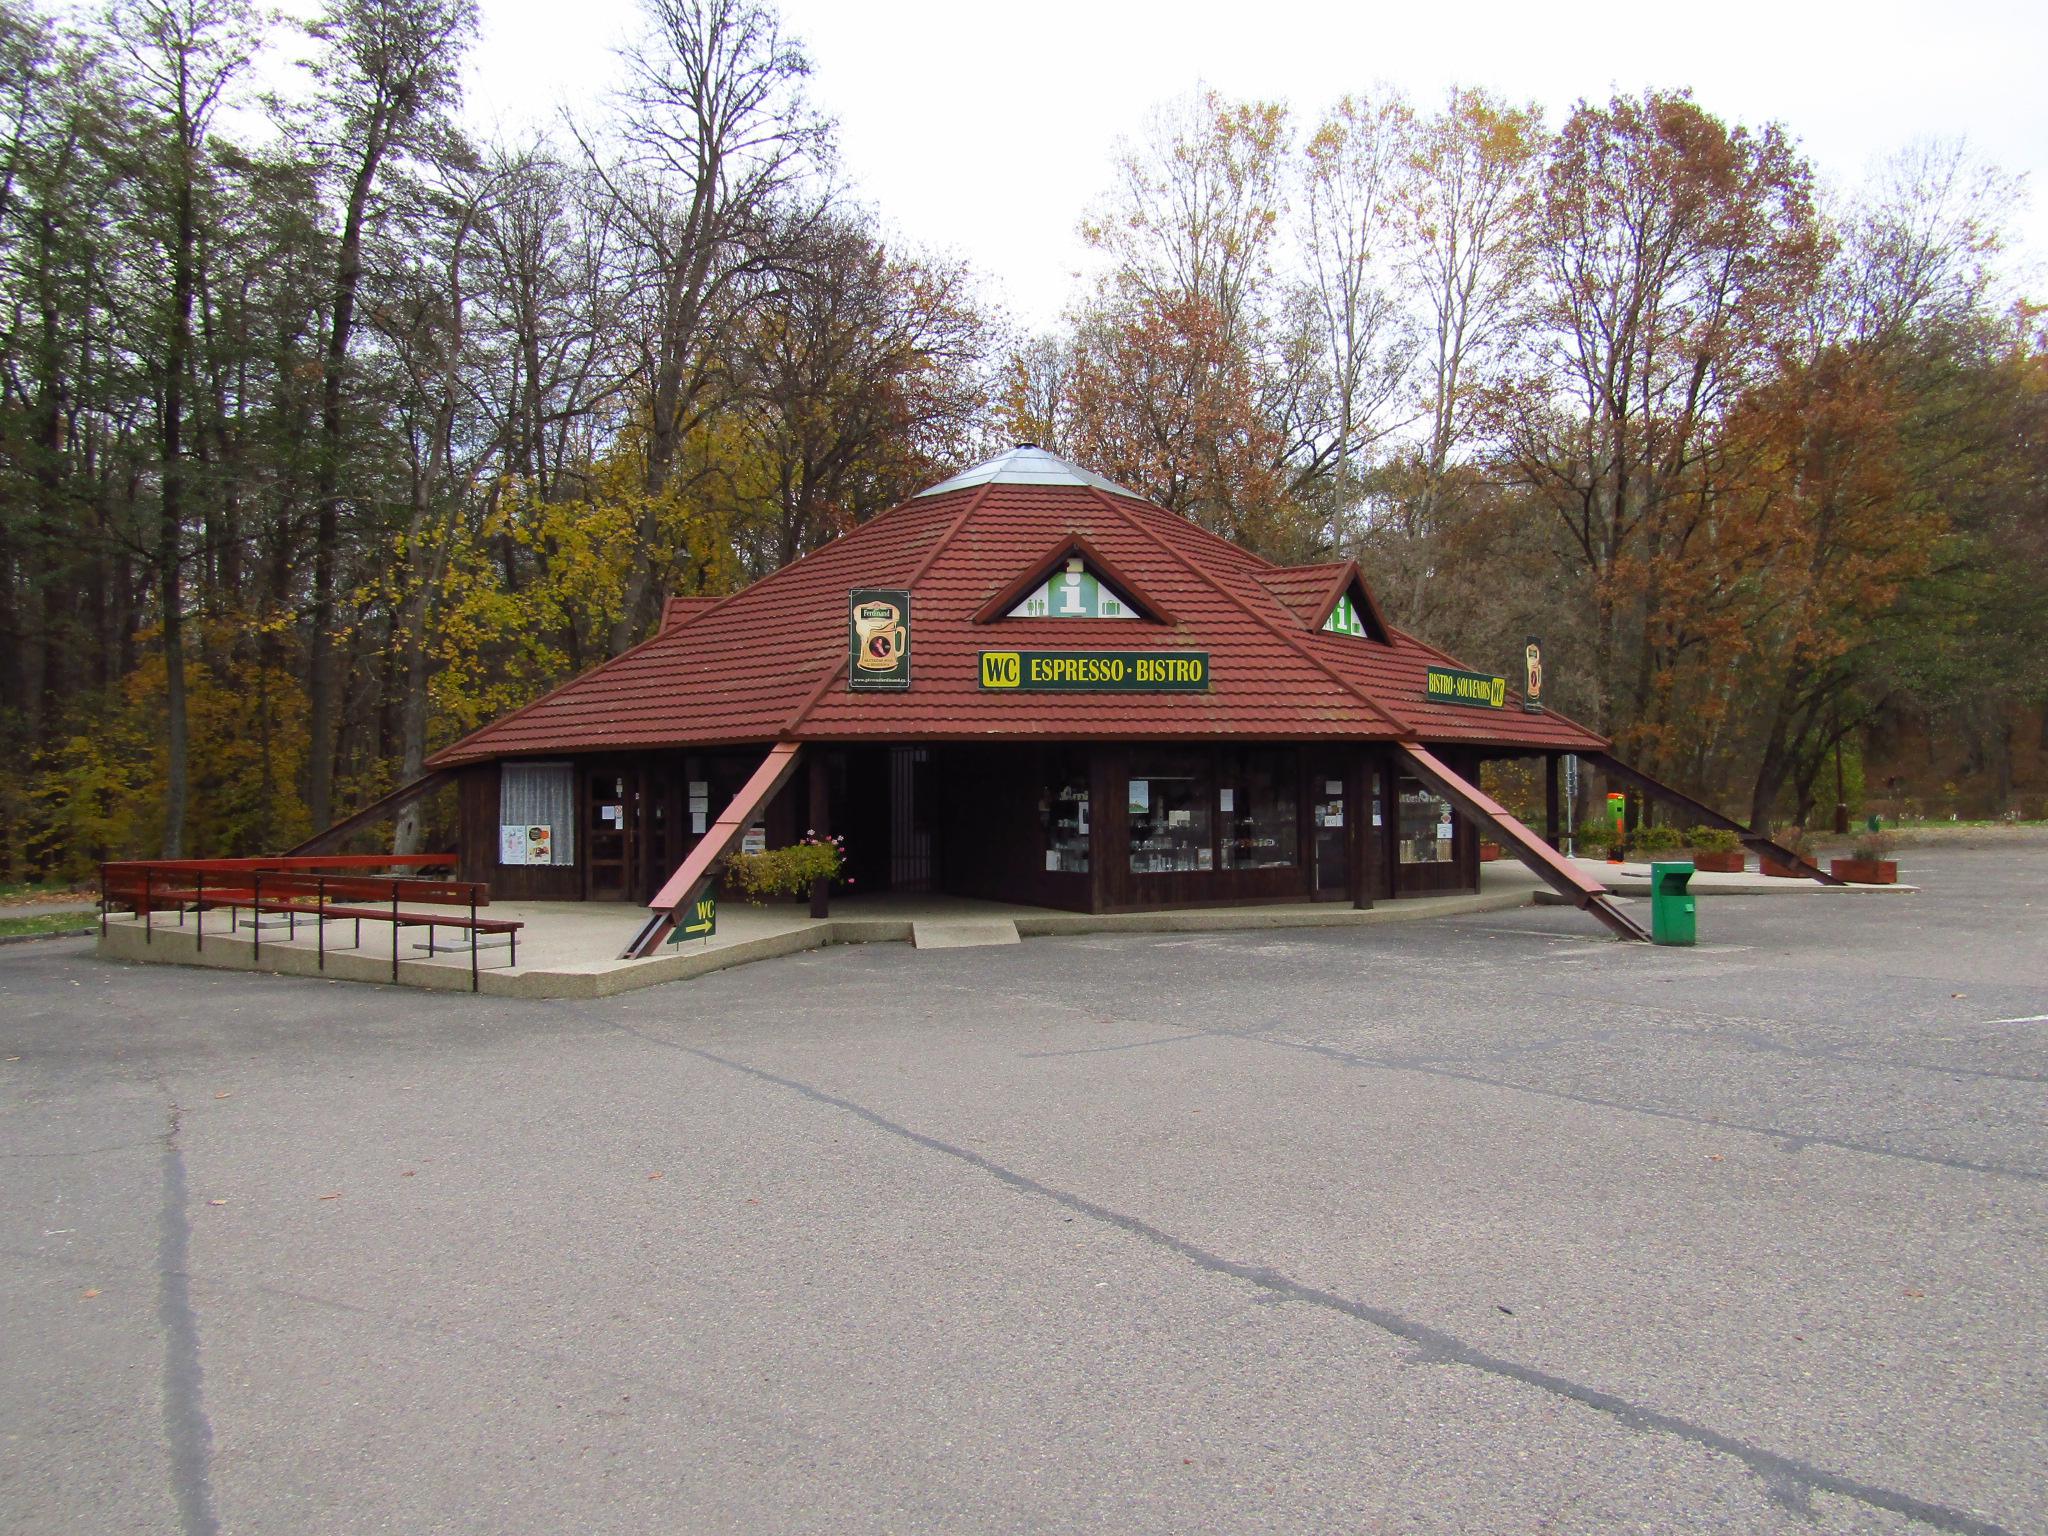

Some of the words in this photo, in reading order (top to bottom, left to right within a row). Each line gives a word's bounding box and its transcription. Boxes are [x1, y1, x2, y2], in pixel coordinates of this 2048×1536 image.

[863, 609, 890, 617] Ferdinand
[986, 657, 1017, 682] WC
[1031, 659, 1124, 682] ESPRESSO
[1136, 659, 1202, 682] BISTRO
[1428, 673, 1453, 695] BISTRO
[1456, 677, 1491, 701] SOUVENIRS
[1493, 681, 1503, 703] WC
[697, 900, 715, 920] WC
